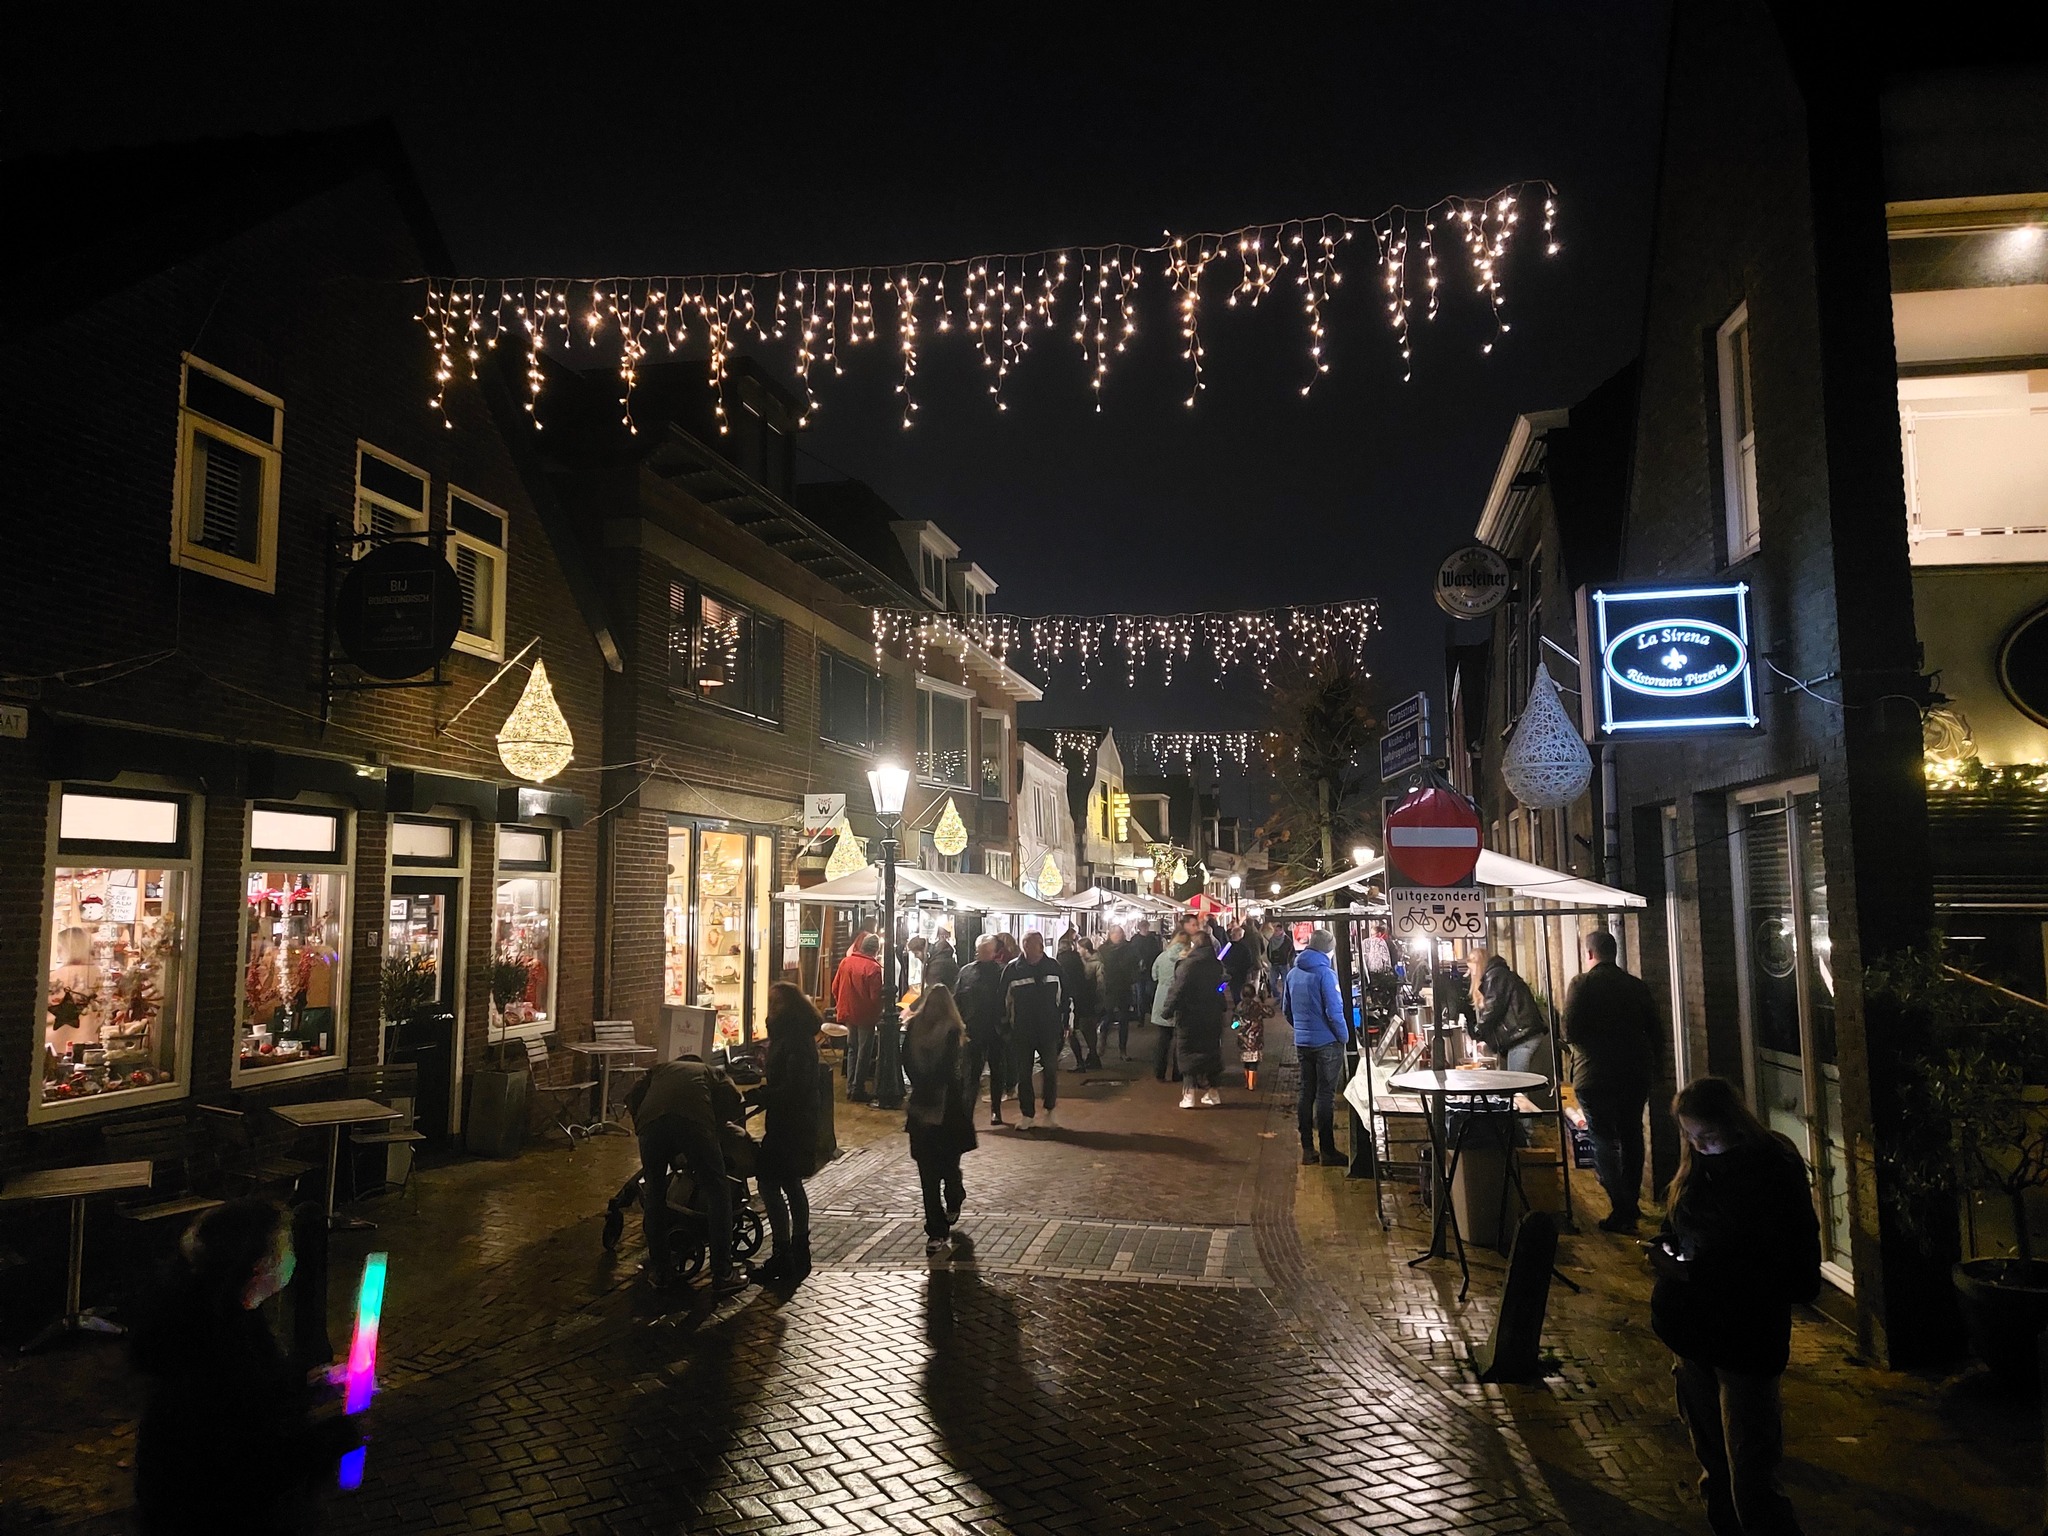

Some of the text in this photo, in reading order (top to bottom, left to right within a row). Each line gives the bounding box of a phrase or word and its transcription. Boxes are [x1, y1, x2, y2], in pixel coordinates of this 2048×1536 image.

[390, 579, 408, 592] BIJ
[1442, 569, 1506, 588] Warsteiner
[1638, 628, 1711, 650] La Sirena
[1627, 664, 1728, 687] Ristorante Pizzeria
[1389, 702, 1418, 724] Dorpsstraat
[1396, 891, 1480, 903] uitgezonderd
